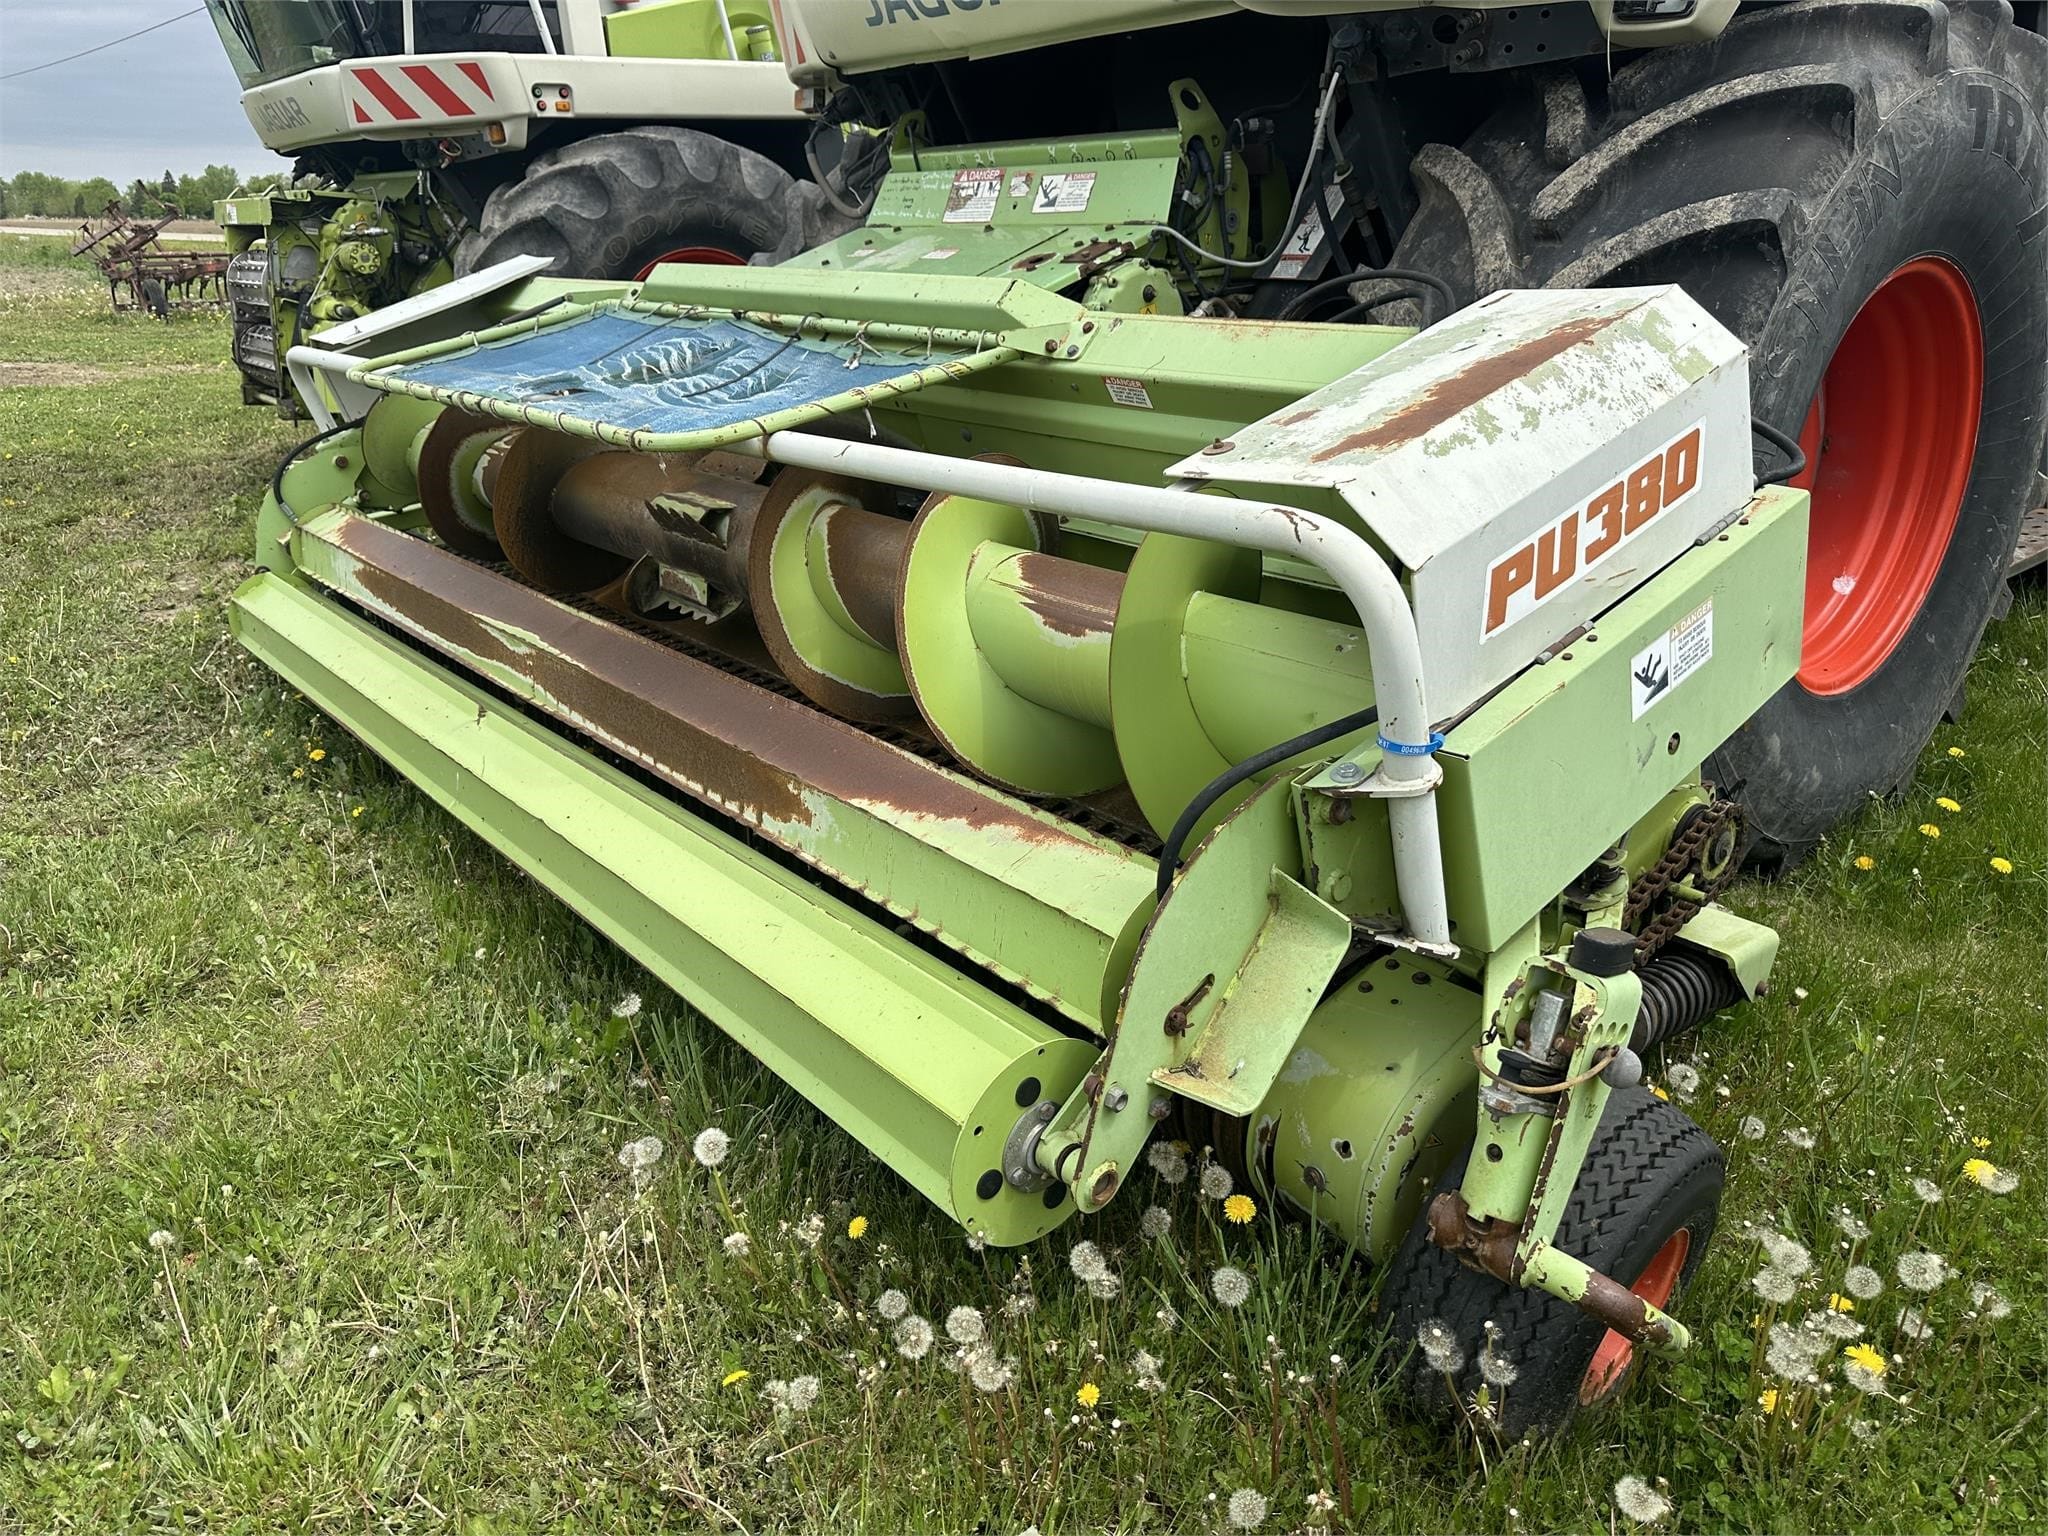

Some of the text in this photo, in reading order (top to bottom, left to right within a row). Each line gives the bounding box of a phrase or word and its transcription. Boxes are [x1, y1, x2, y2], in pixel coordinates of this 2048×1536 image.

[254, 96, 312, 133] JAGUAR
[1110, 377, 1143, 389] DANGER
[1680, 600, 1713, 632] DANGER
